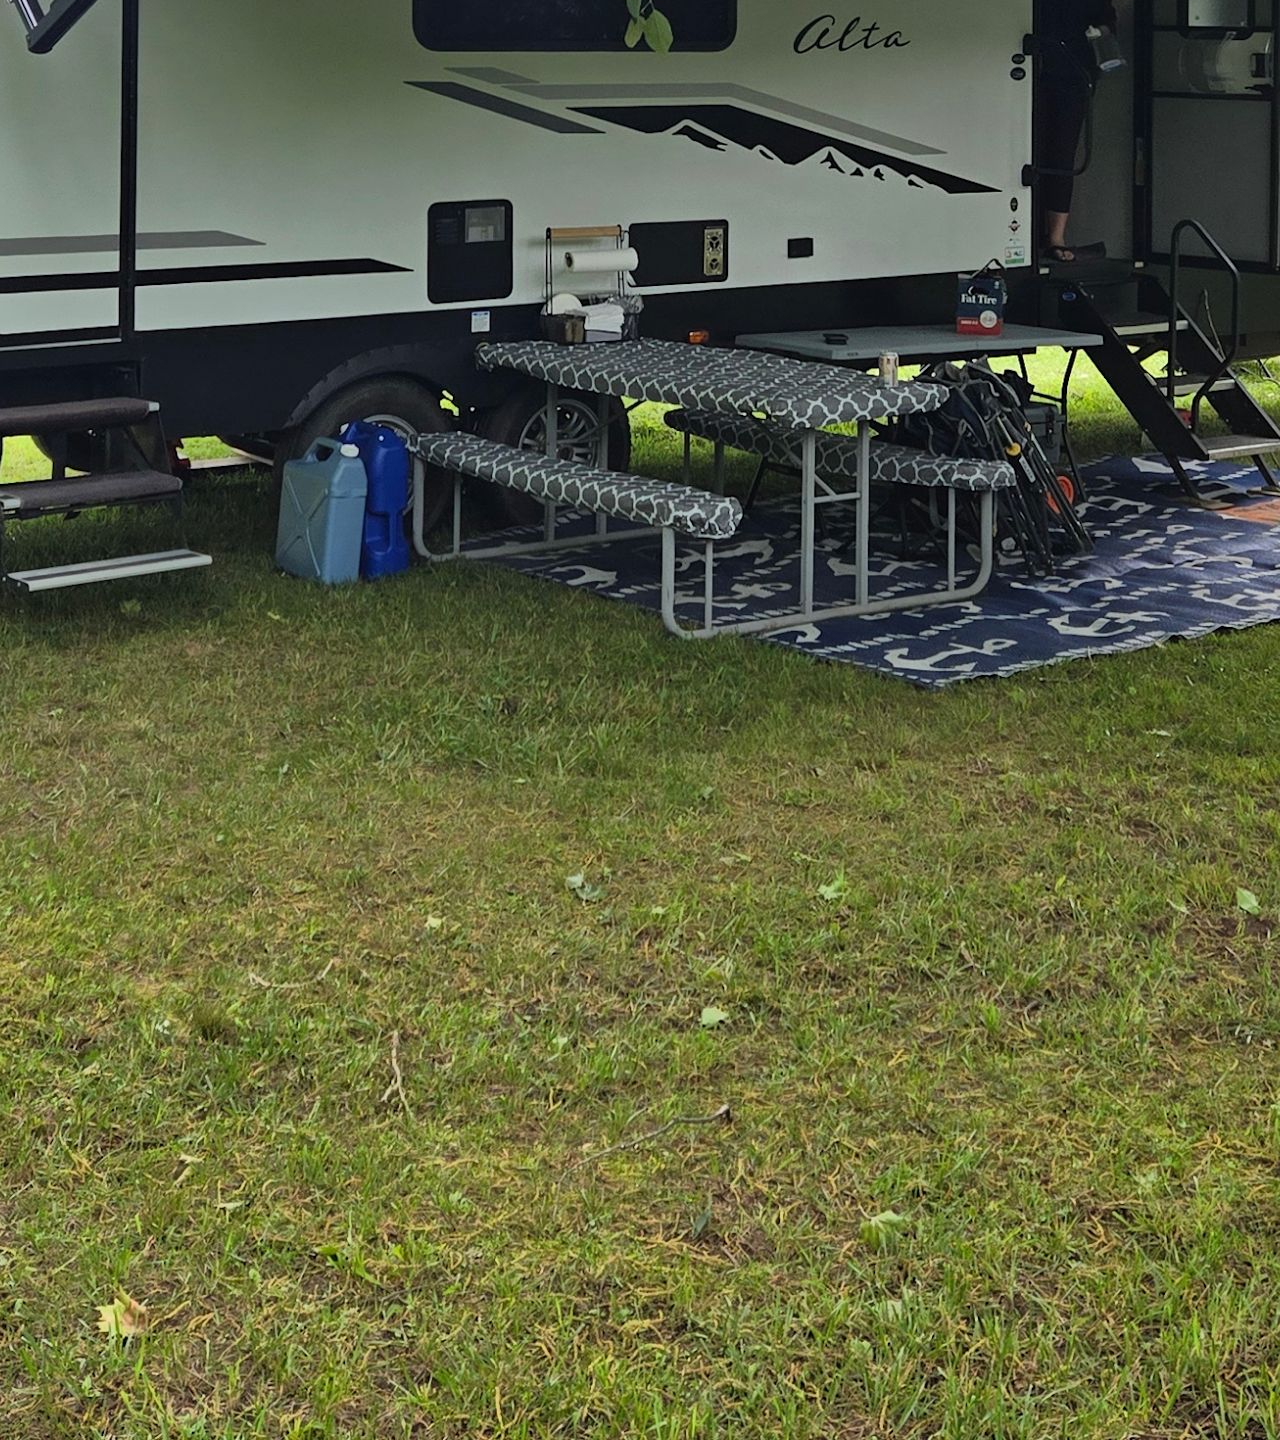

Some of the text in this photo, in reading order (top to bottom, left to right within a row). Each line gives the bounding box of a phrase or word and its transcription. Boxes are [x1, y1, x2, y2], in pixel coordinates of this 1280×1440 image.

[793, 14, 911, 54] Alta
[961, 293, 997, 305] Fat Tire
